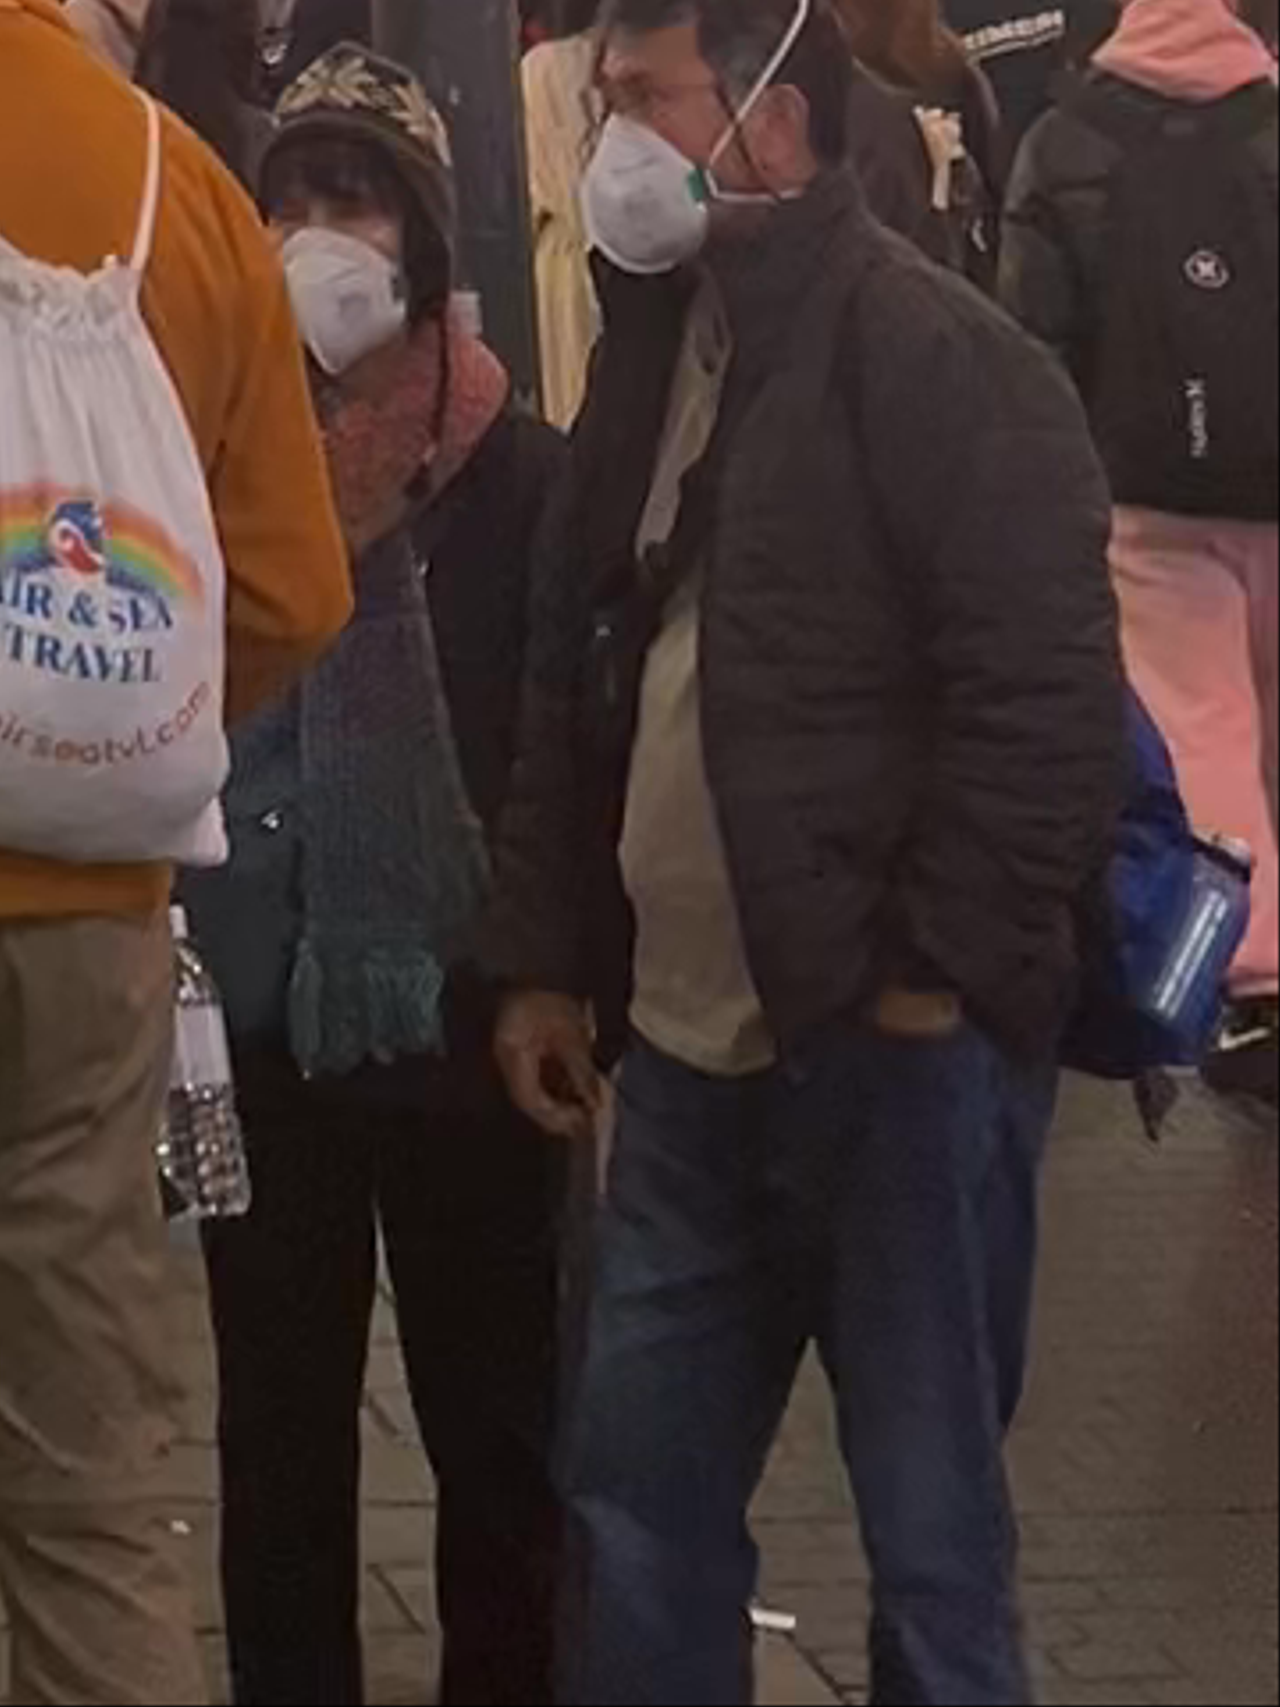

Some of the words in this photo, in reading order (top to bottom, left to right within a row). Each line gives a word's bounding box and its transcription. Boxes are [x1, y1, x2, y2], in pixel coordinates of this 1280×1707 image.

[68, 590, 99, 627] &
[107, 595, 175, 632] SEA
[3, 621, 162, 683] TRAVEL
